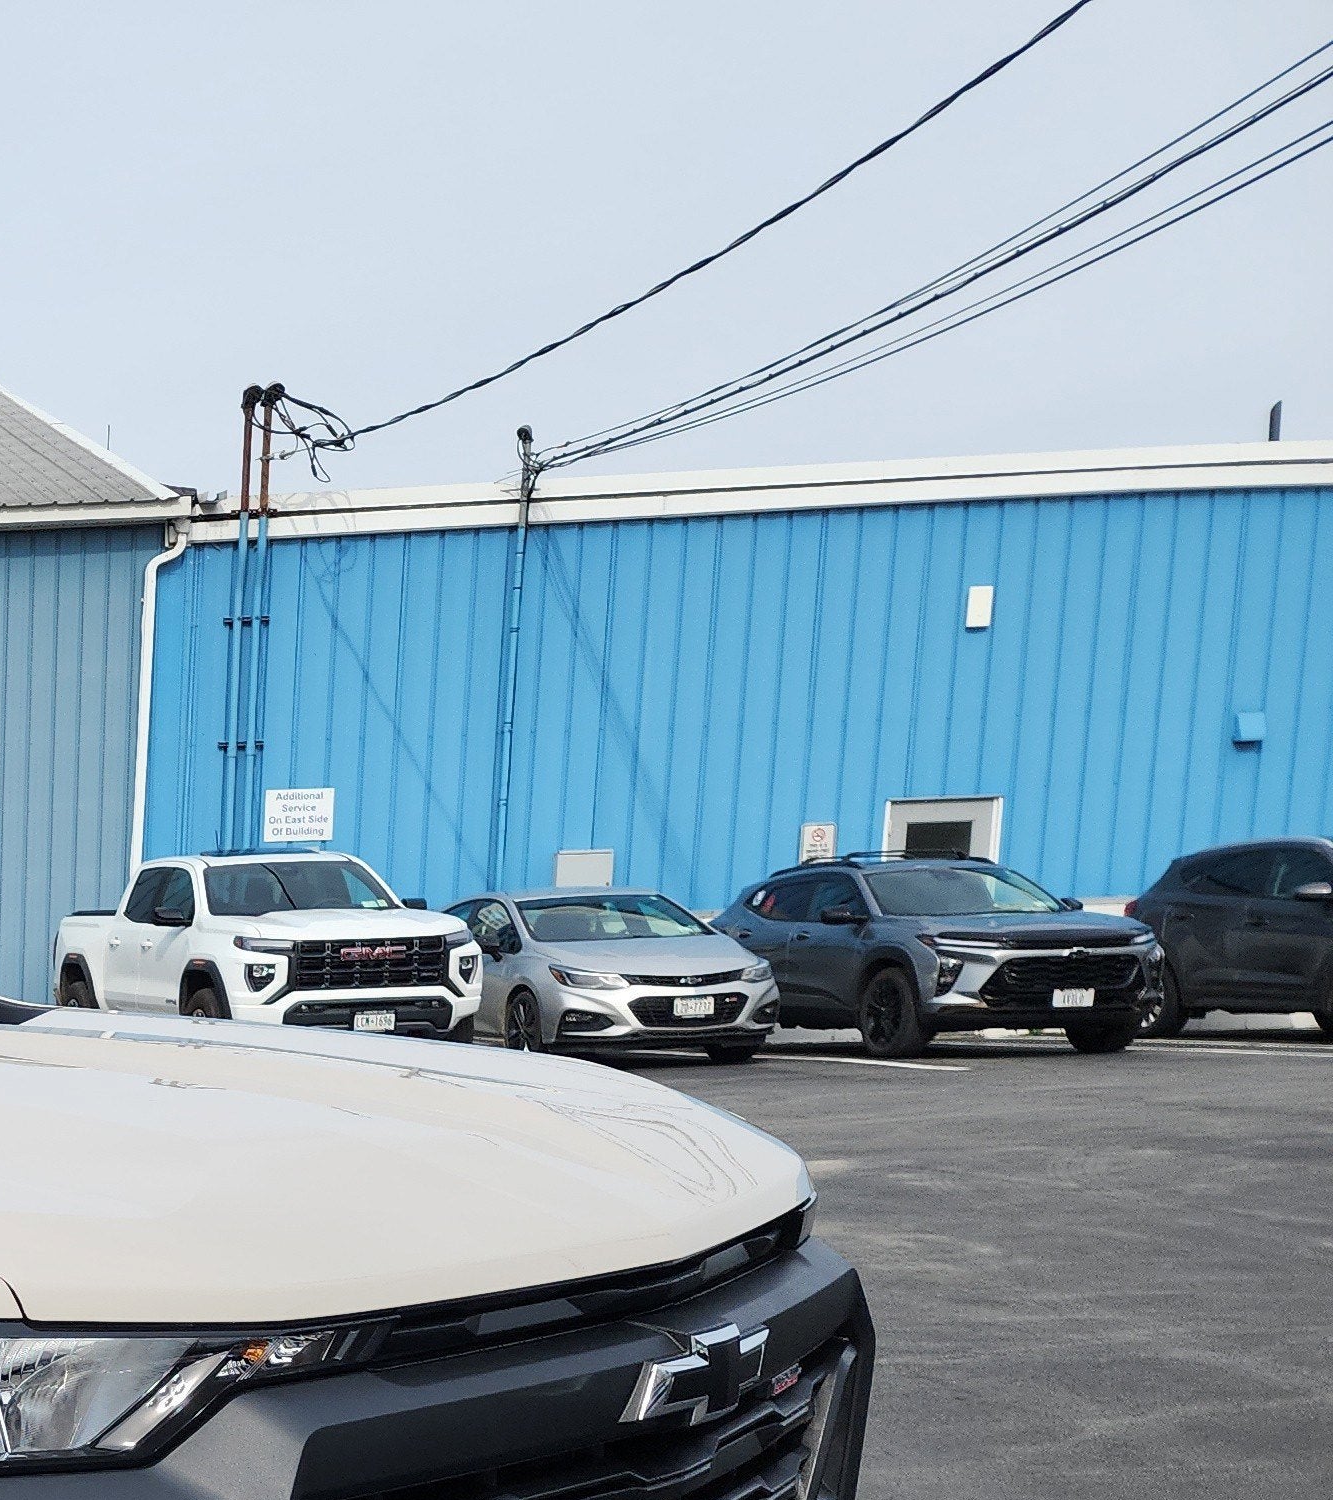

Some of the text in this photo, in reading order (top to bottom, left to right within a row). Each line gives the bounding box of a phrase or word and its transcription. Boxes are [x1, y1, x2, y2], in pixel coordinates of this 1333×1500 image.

[275, 791, 324, 801] Additional
[281, 804, 317, 813] Service
[268, 815, 329, 825] On East Side
[271, 827, 325, 837] Of Building
[340, 945, 408, 962] GMC
